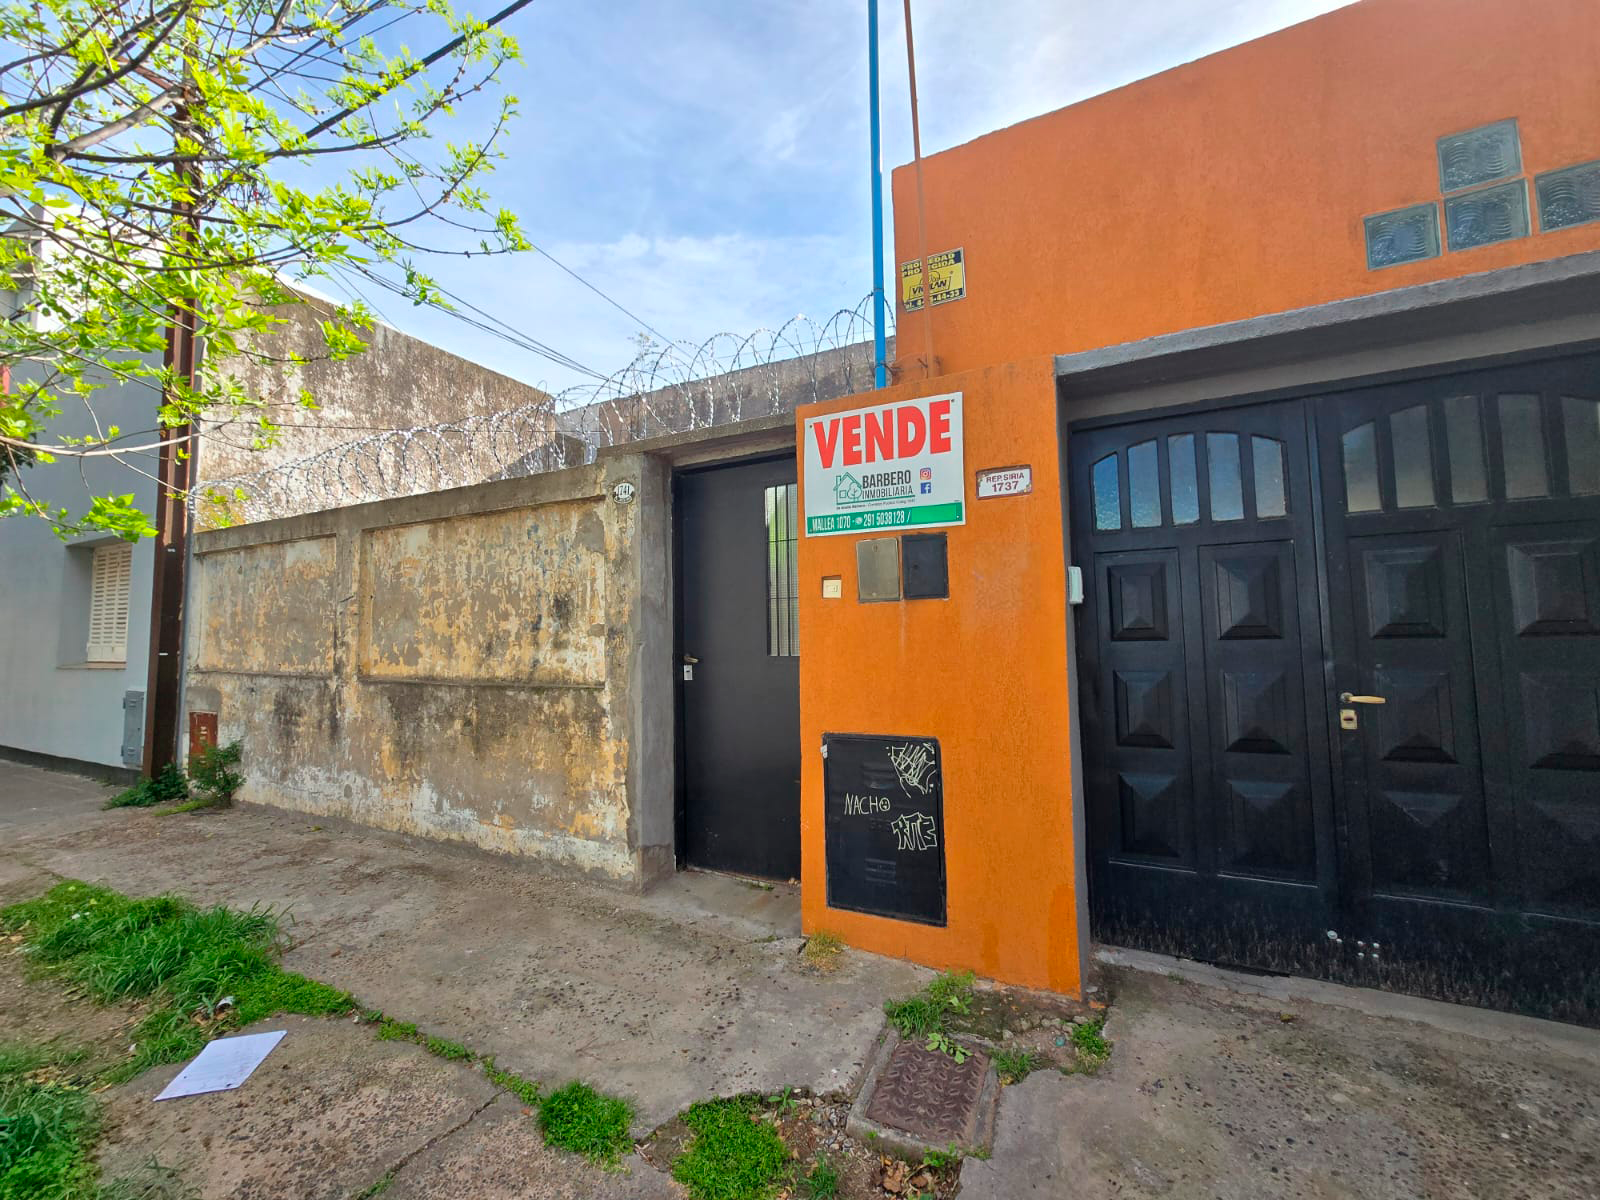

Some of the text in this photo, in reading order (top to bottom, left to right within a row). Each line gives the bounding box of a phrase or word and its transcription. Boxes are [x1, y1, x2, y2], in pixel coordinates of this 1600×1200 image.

[902, 253, 955, 271] PROEDAD
[902, 260, 955, 278] PROGIDA
[813, 400, 952, 469] VENDE
[862, 469, 912, 489] BARBERO
[992, 480, 1019, 492] 1737
[862, 485, 914, 500] INMOBILIARIA
[811, 516, 835, 531] MALLEA
[837, 515, 851, 529] 1070
[863, 513, 876, 527] 291
